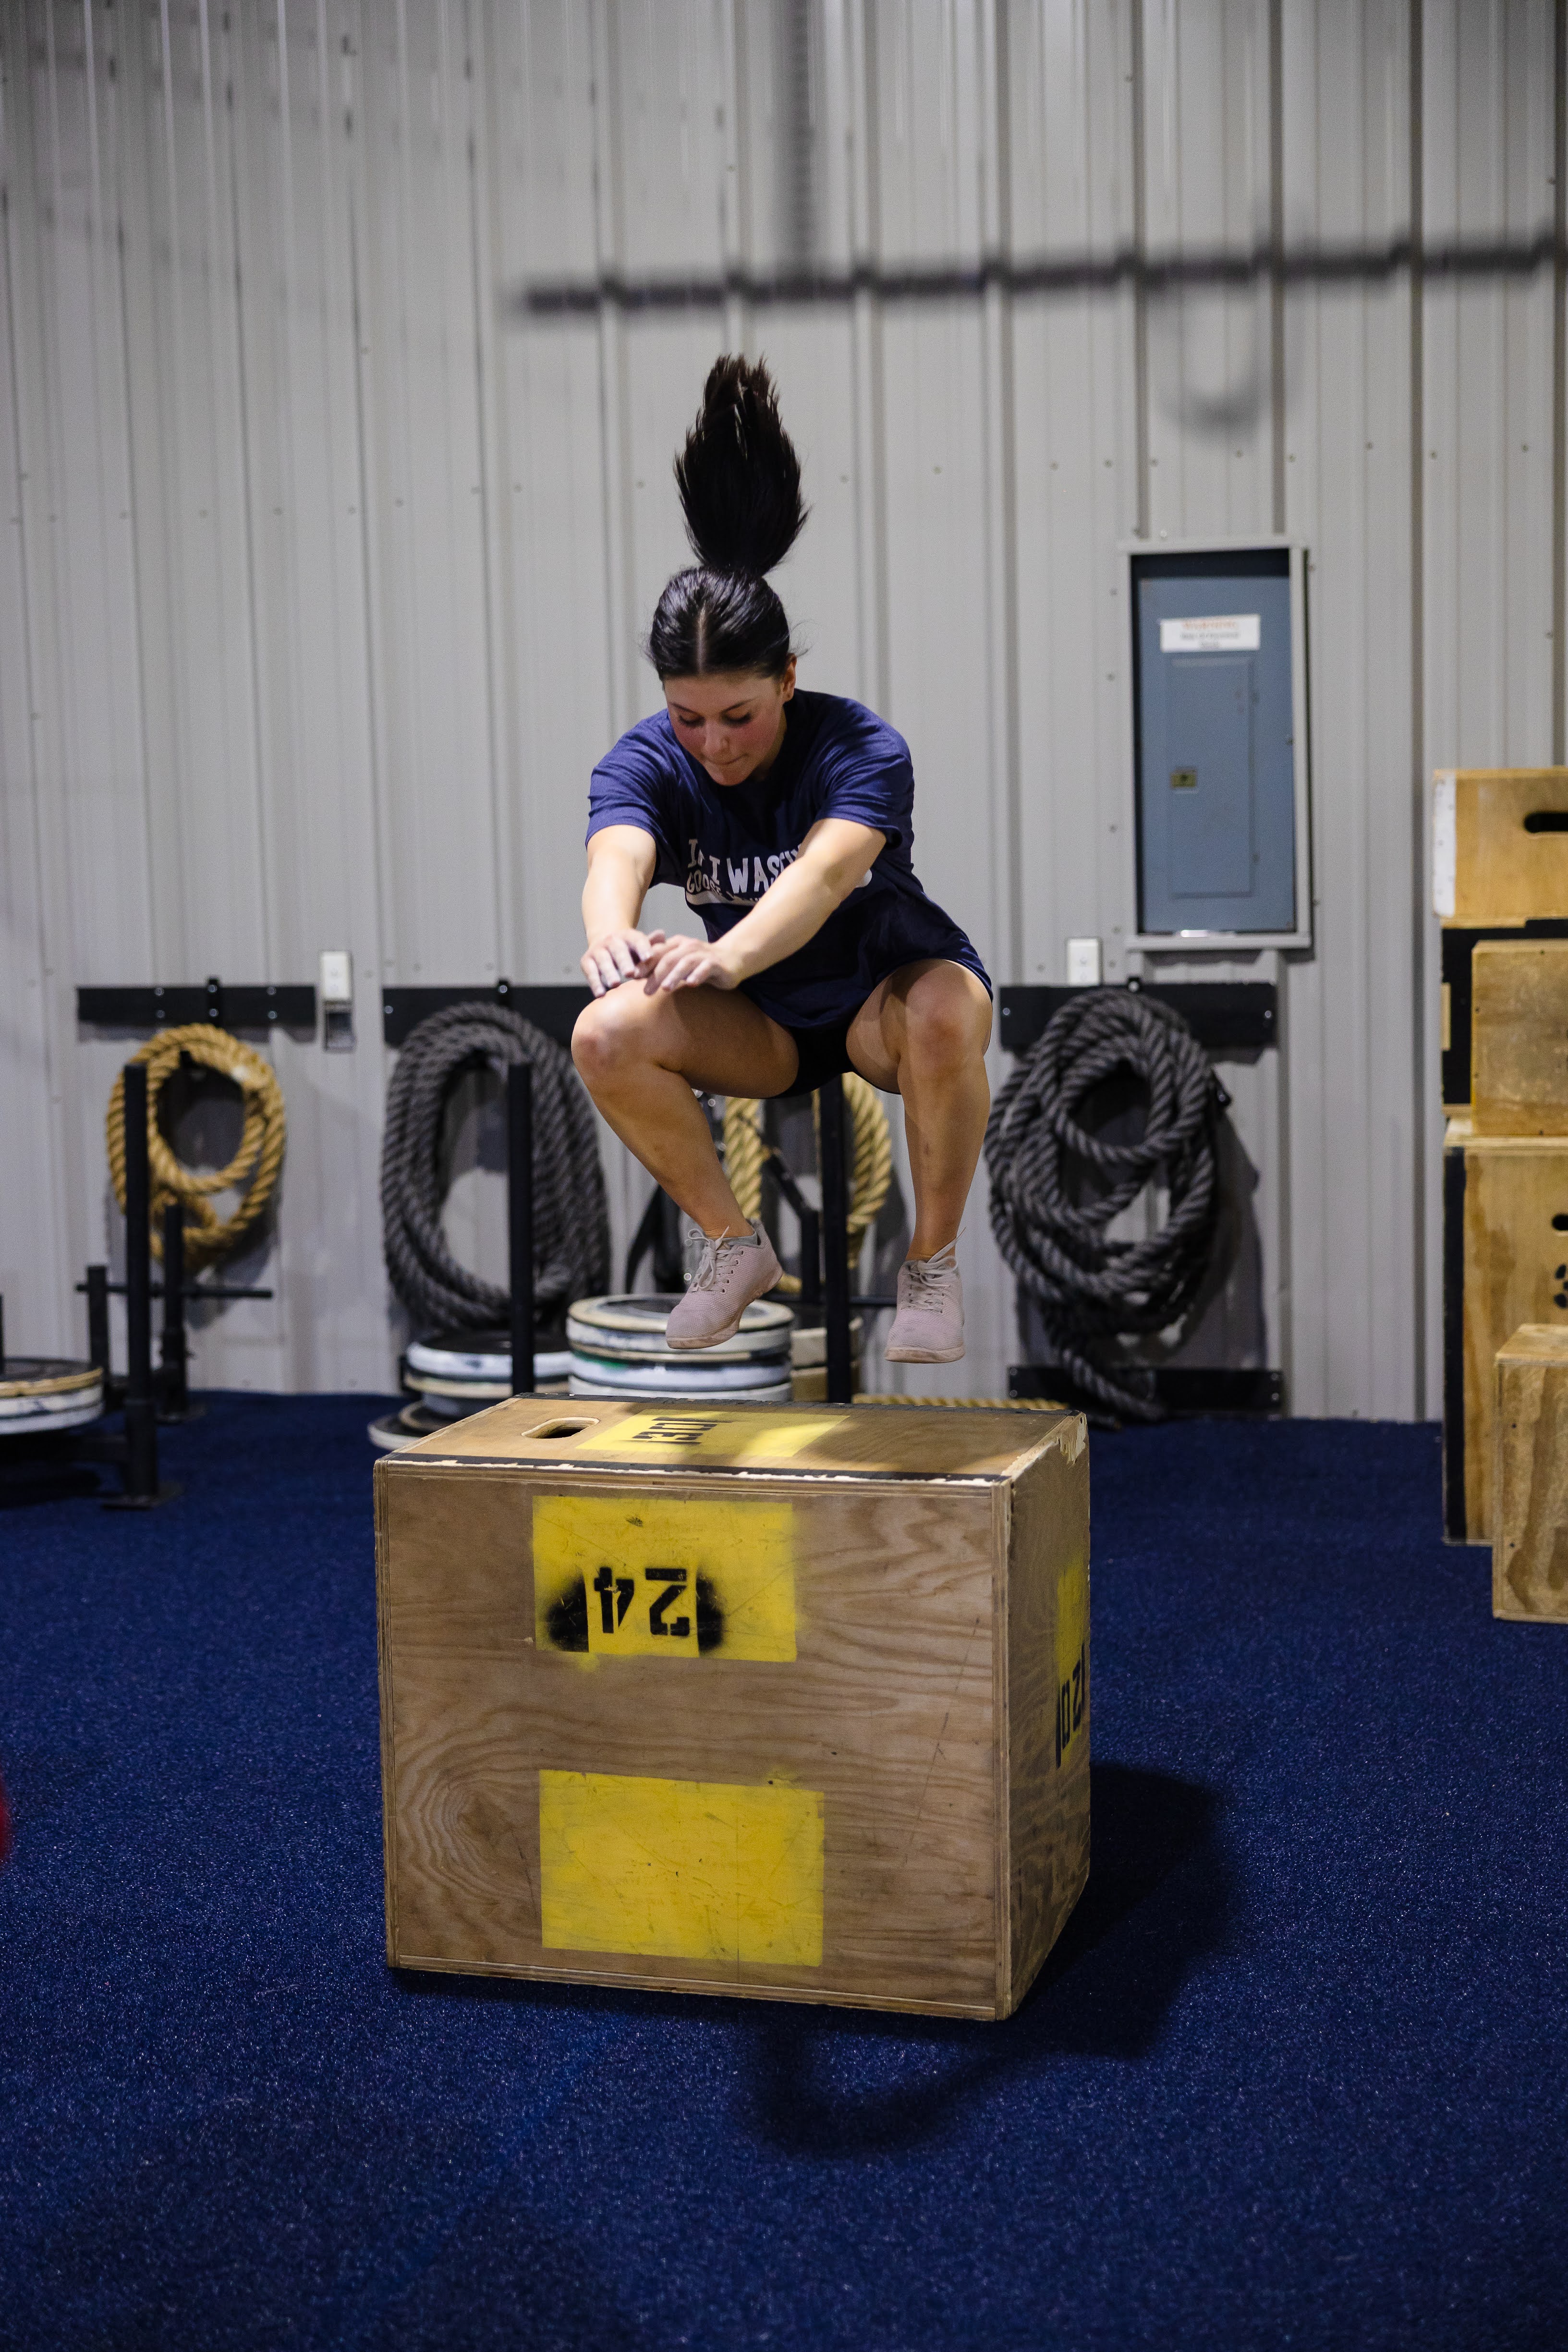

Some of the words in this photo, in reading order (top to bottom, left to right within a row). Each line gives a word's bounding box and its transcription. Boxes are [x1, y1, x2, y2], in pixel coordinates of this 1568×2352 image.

[632, 1422, 717, 1441] 30
[594, 1566, 690, 1636] 24
[1061, 1659, 1082, 1750] 20
